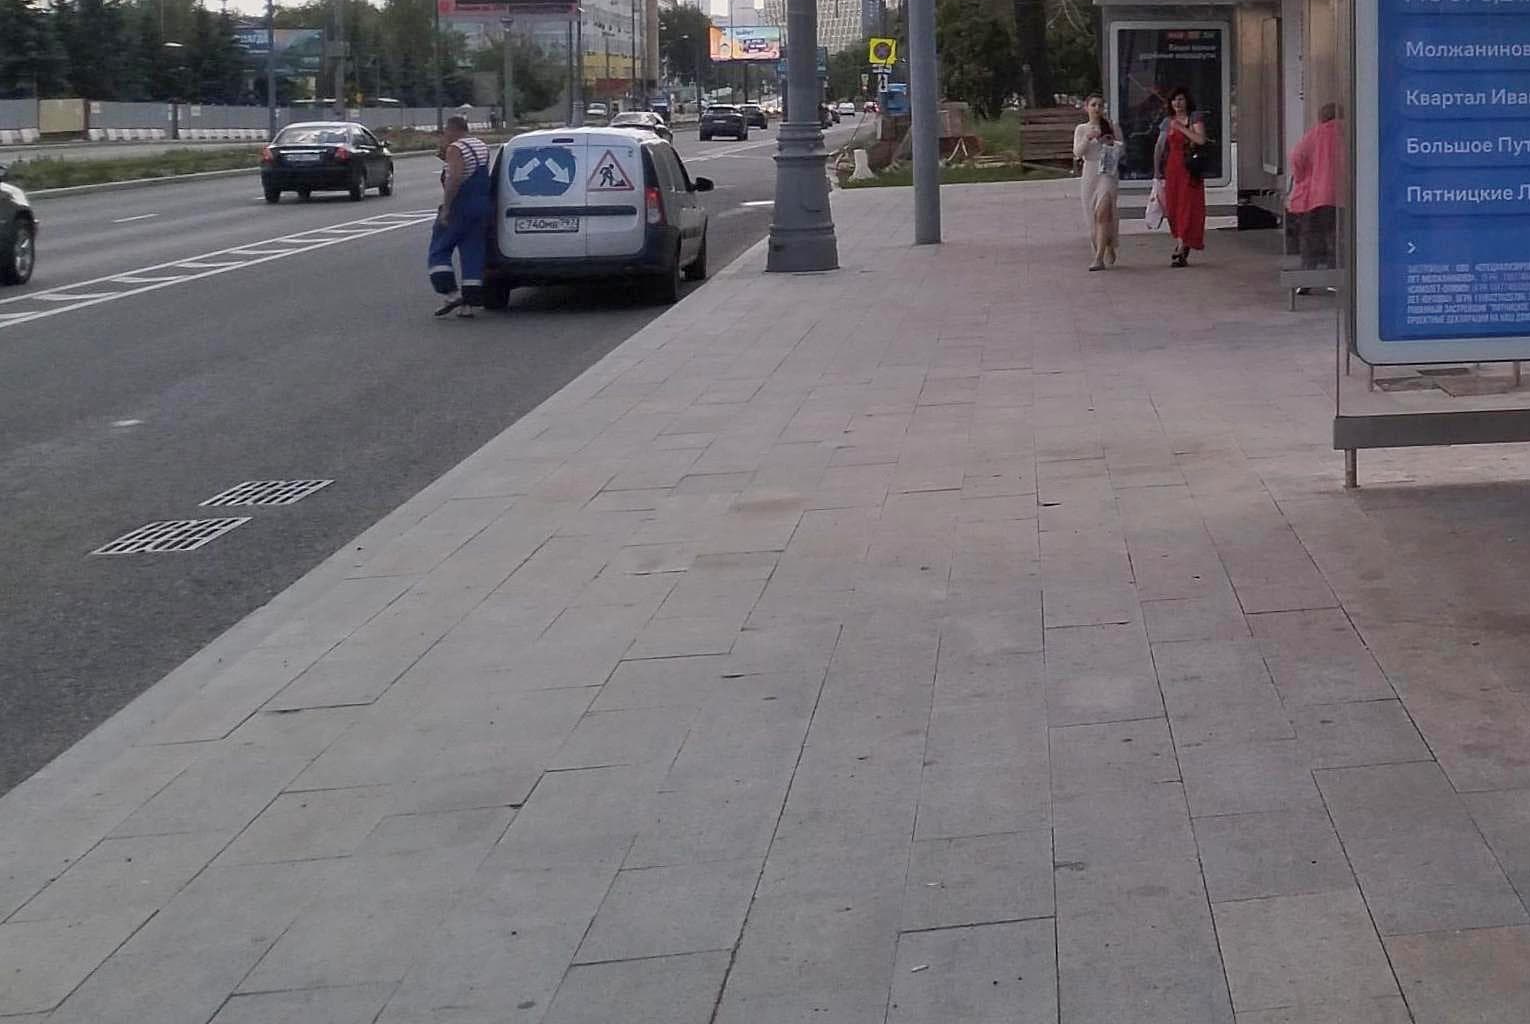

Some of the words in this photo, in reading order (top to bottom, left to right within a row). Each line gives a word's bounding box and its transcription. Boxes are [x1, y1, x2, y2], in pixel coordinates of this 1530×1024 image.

[1405, 89, 1486, 108] Квартал
[1406, 137, 1493, 154] Большое
[1406, 185, 1514, 204] Пятницкие
